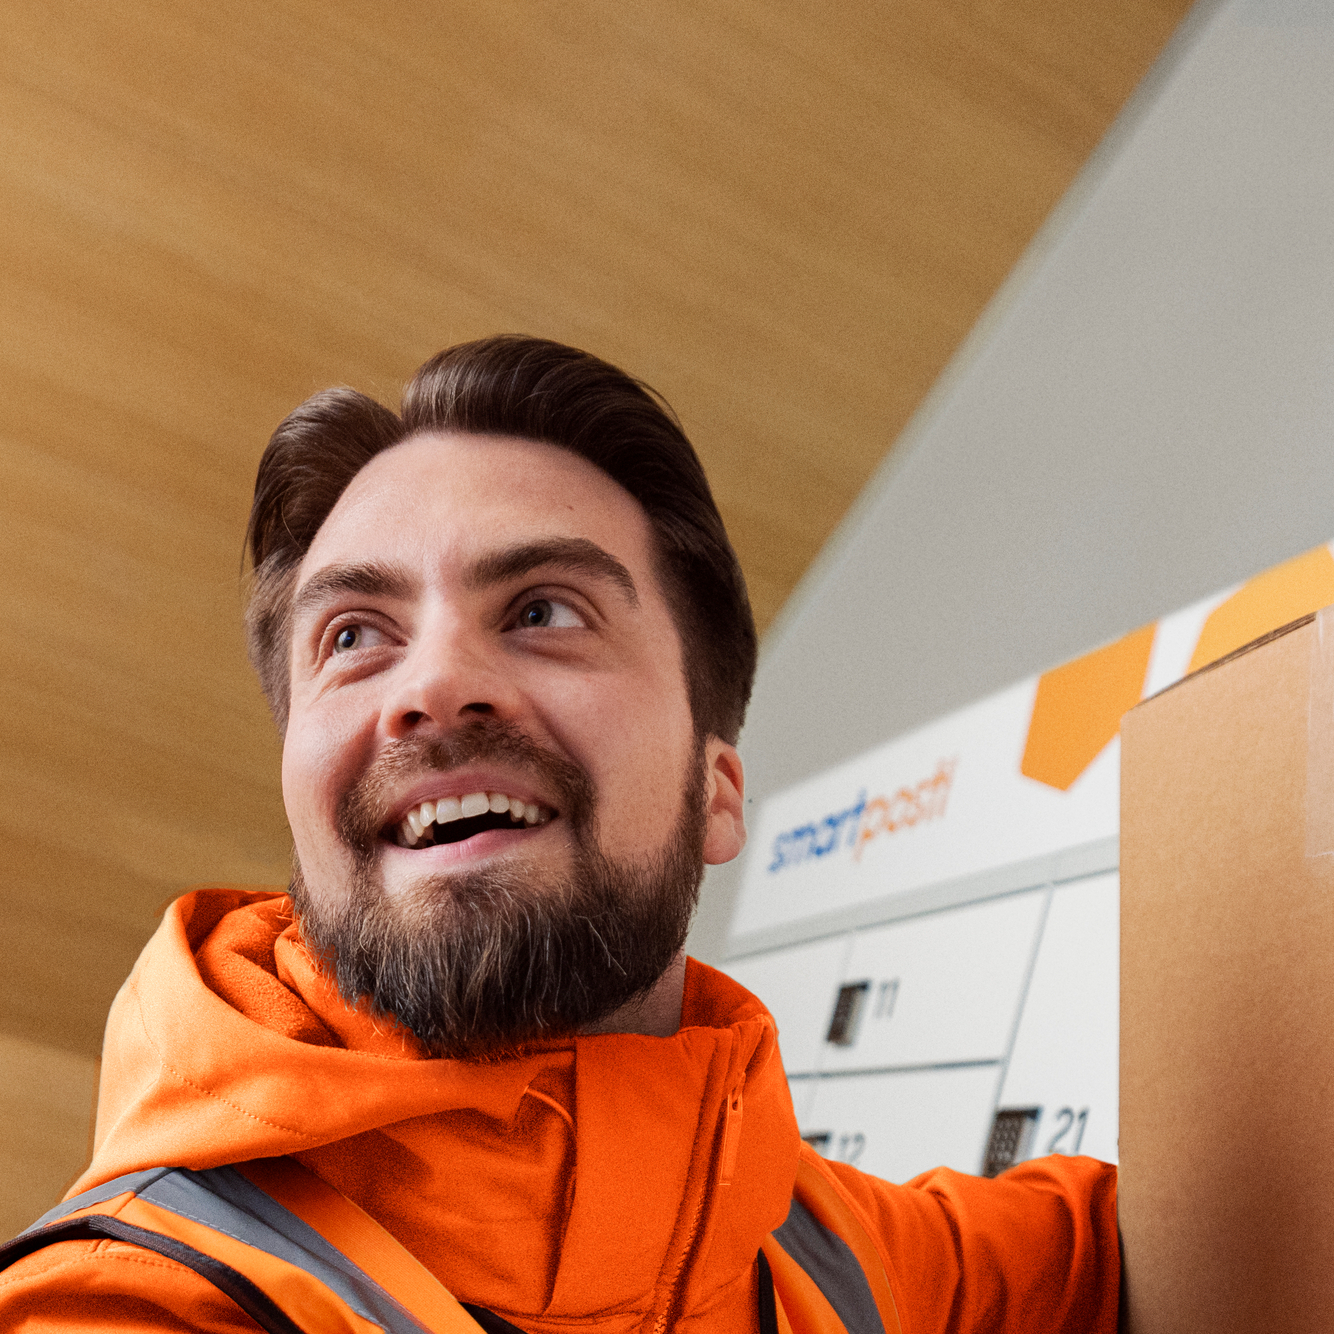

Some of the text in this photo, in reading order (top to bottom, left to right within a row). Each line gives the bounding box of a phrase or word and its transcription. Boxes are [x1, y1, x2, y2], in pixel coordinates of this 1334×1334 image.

[768, 758, 956, 873] smartposti
[871, 976, 899, 1018] 11
[1047, 1106, 1089, 1156] 21
